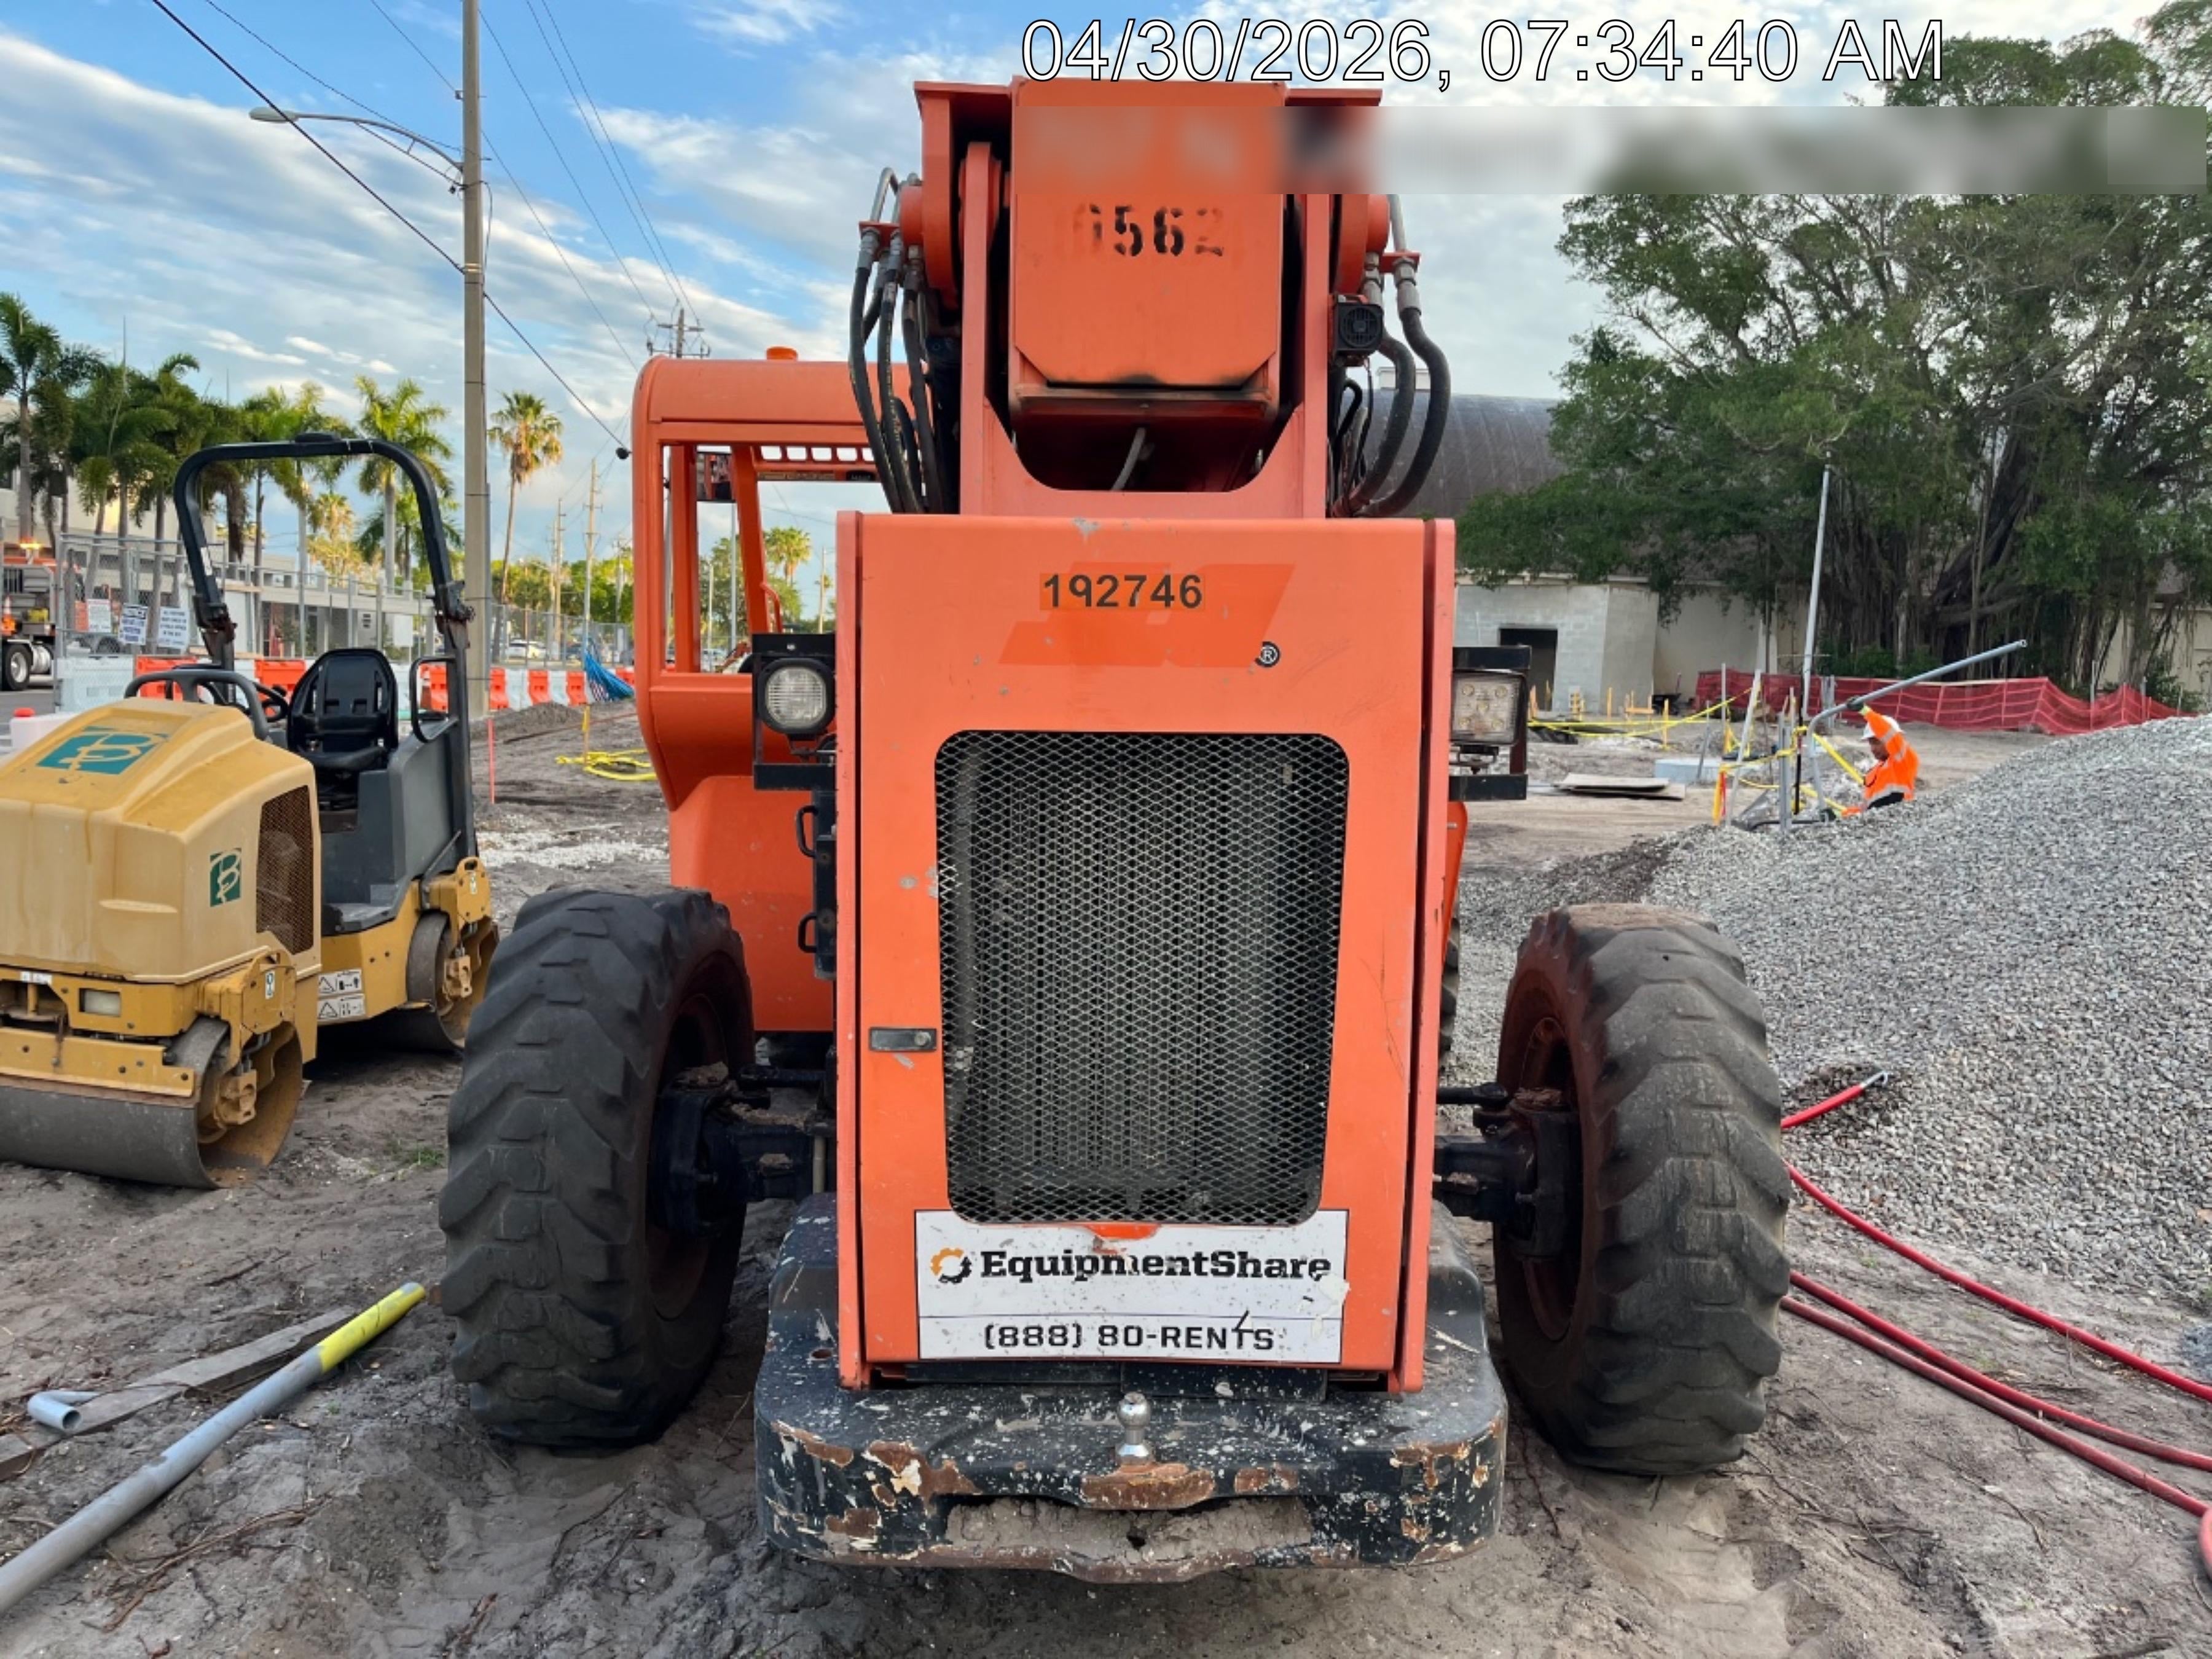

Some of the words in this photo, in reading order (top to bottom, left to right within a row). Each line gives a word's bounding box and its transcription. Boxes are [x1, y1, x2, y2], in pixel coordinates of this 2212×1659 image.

[1044, 574, 1202, 609] 192746
[980, 1249, 1332, 1283] EquipmentShare
[984, 1323, 1082, 1349] (888)
[1098, 1324, 1275, 1351] 80-RENTS
